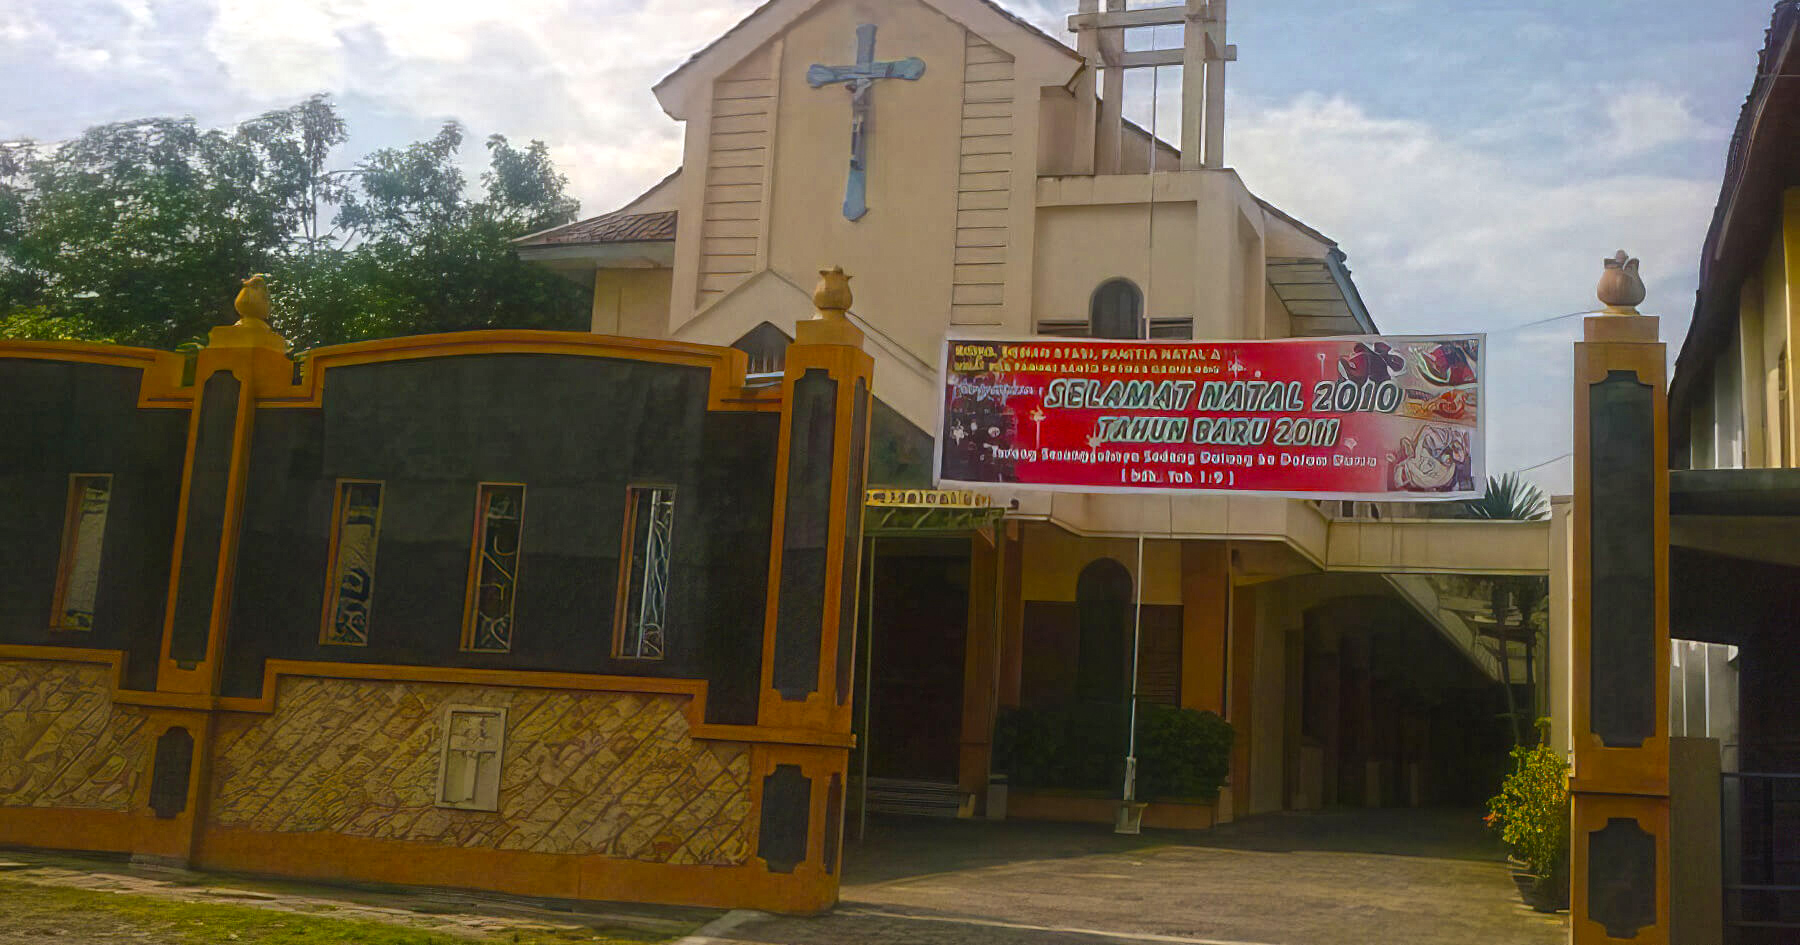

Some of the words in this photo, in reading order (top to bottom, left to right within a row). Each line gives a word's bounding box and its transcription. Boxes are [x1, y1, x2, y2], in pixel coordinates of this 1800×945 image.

[1161, 348, 1206, 361] NATAL
[1044, 378, 1195, 410] SELAMAT
[1198, 381, 1304, 412] NATAL
[1312, 380, 1402, 413] 2010
[1097, 416, 1188, 444] TAHUN
[1193, 417, 1270, 446] BARU
[1274, 417, 1340, 447] 2011
